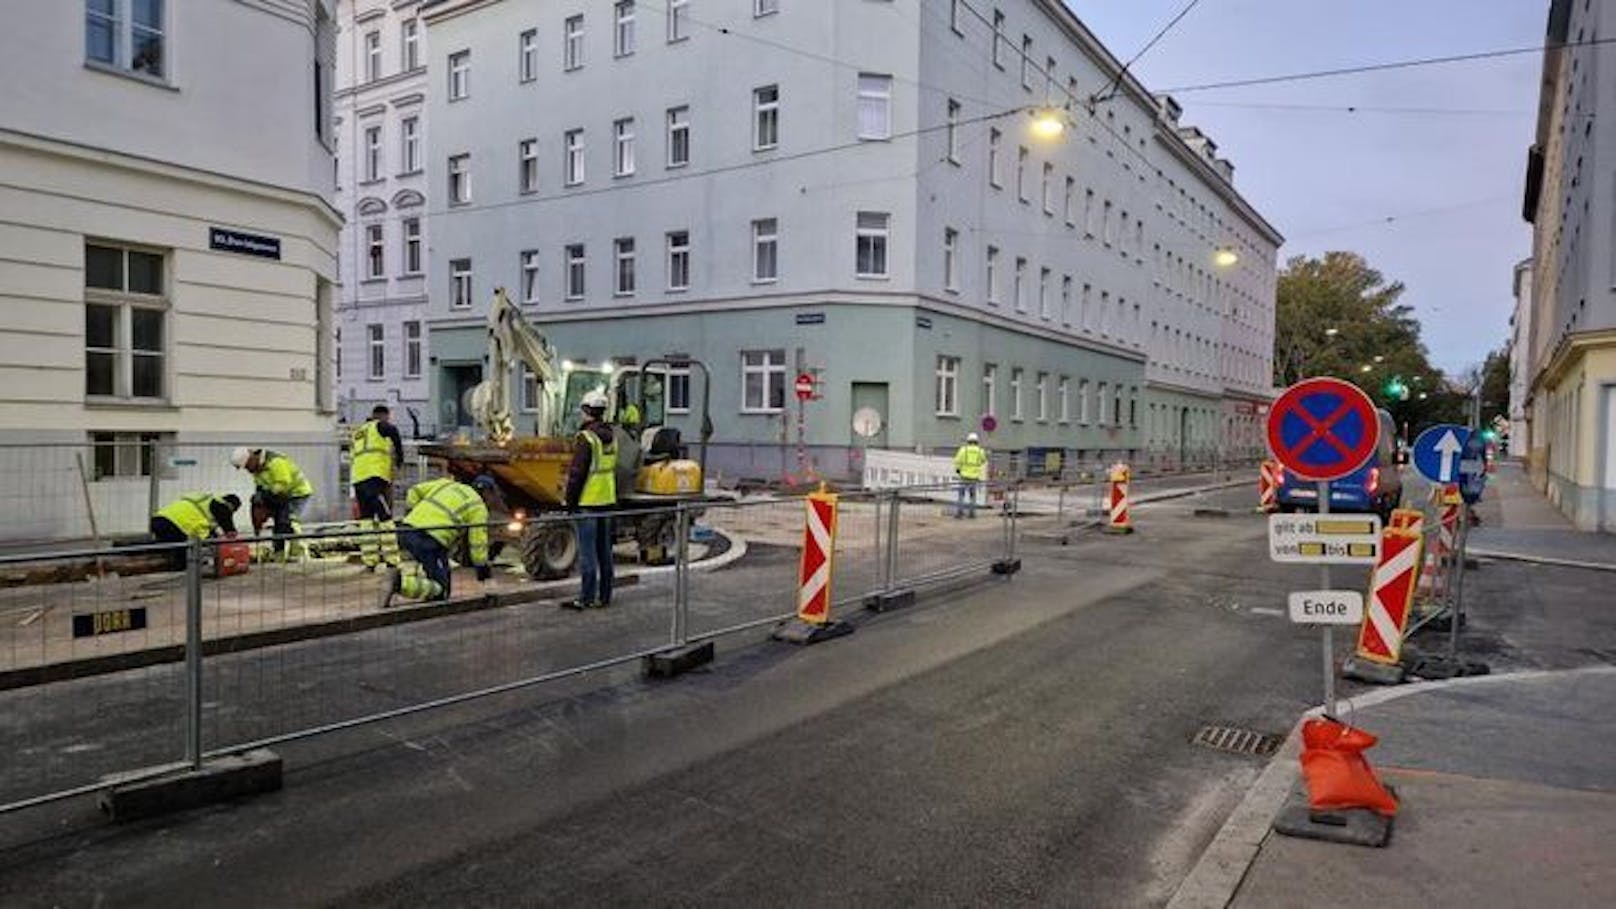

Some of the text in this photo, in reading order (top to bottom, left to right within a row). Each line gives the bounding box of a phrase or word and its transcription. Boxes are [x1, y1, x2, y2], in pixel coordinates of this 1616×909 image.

[1275, 521, 1313, 536] gilt ab
[1275, 543, 1345, 556] von bis
[1303, 600, 1347, 615] Ende
